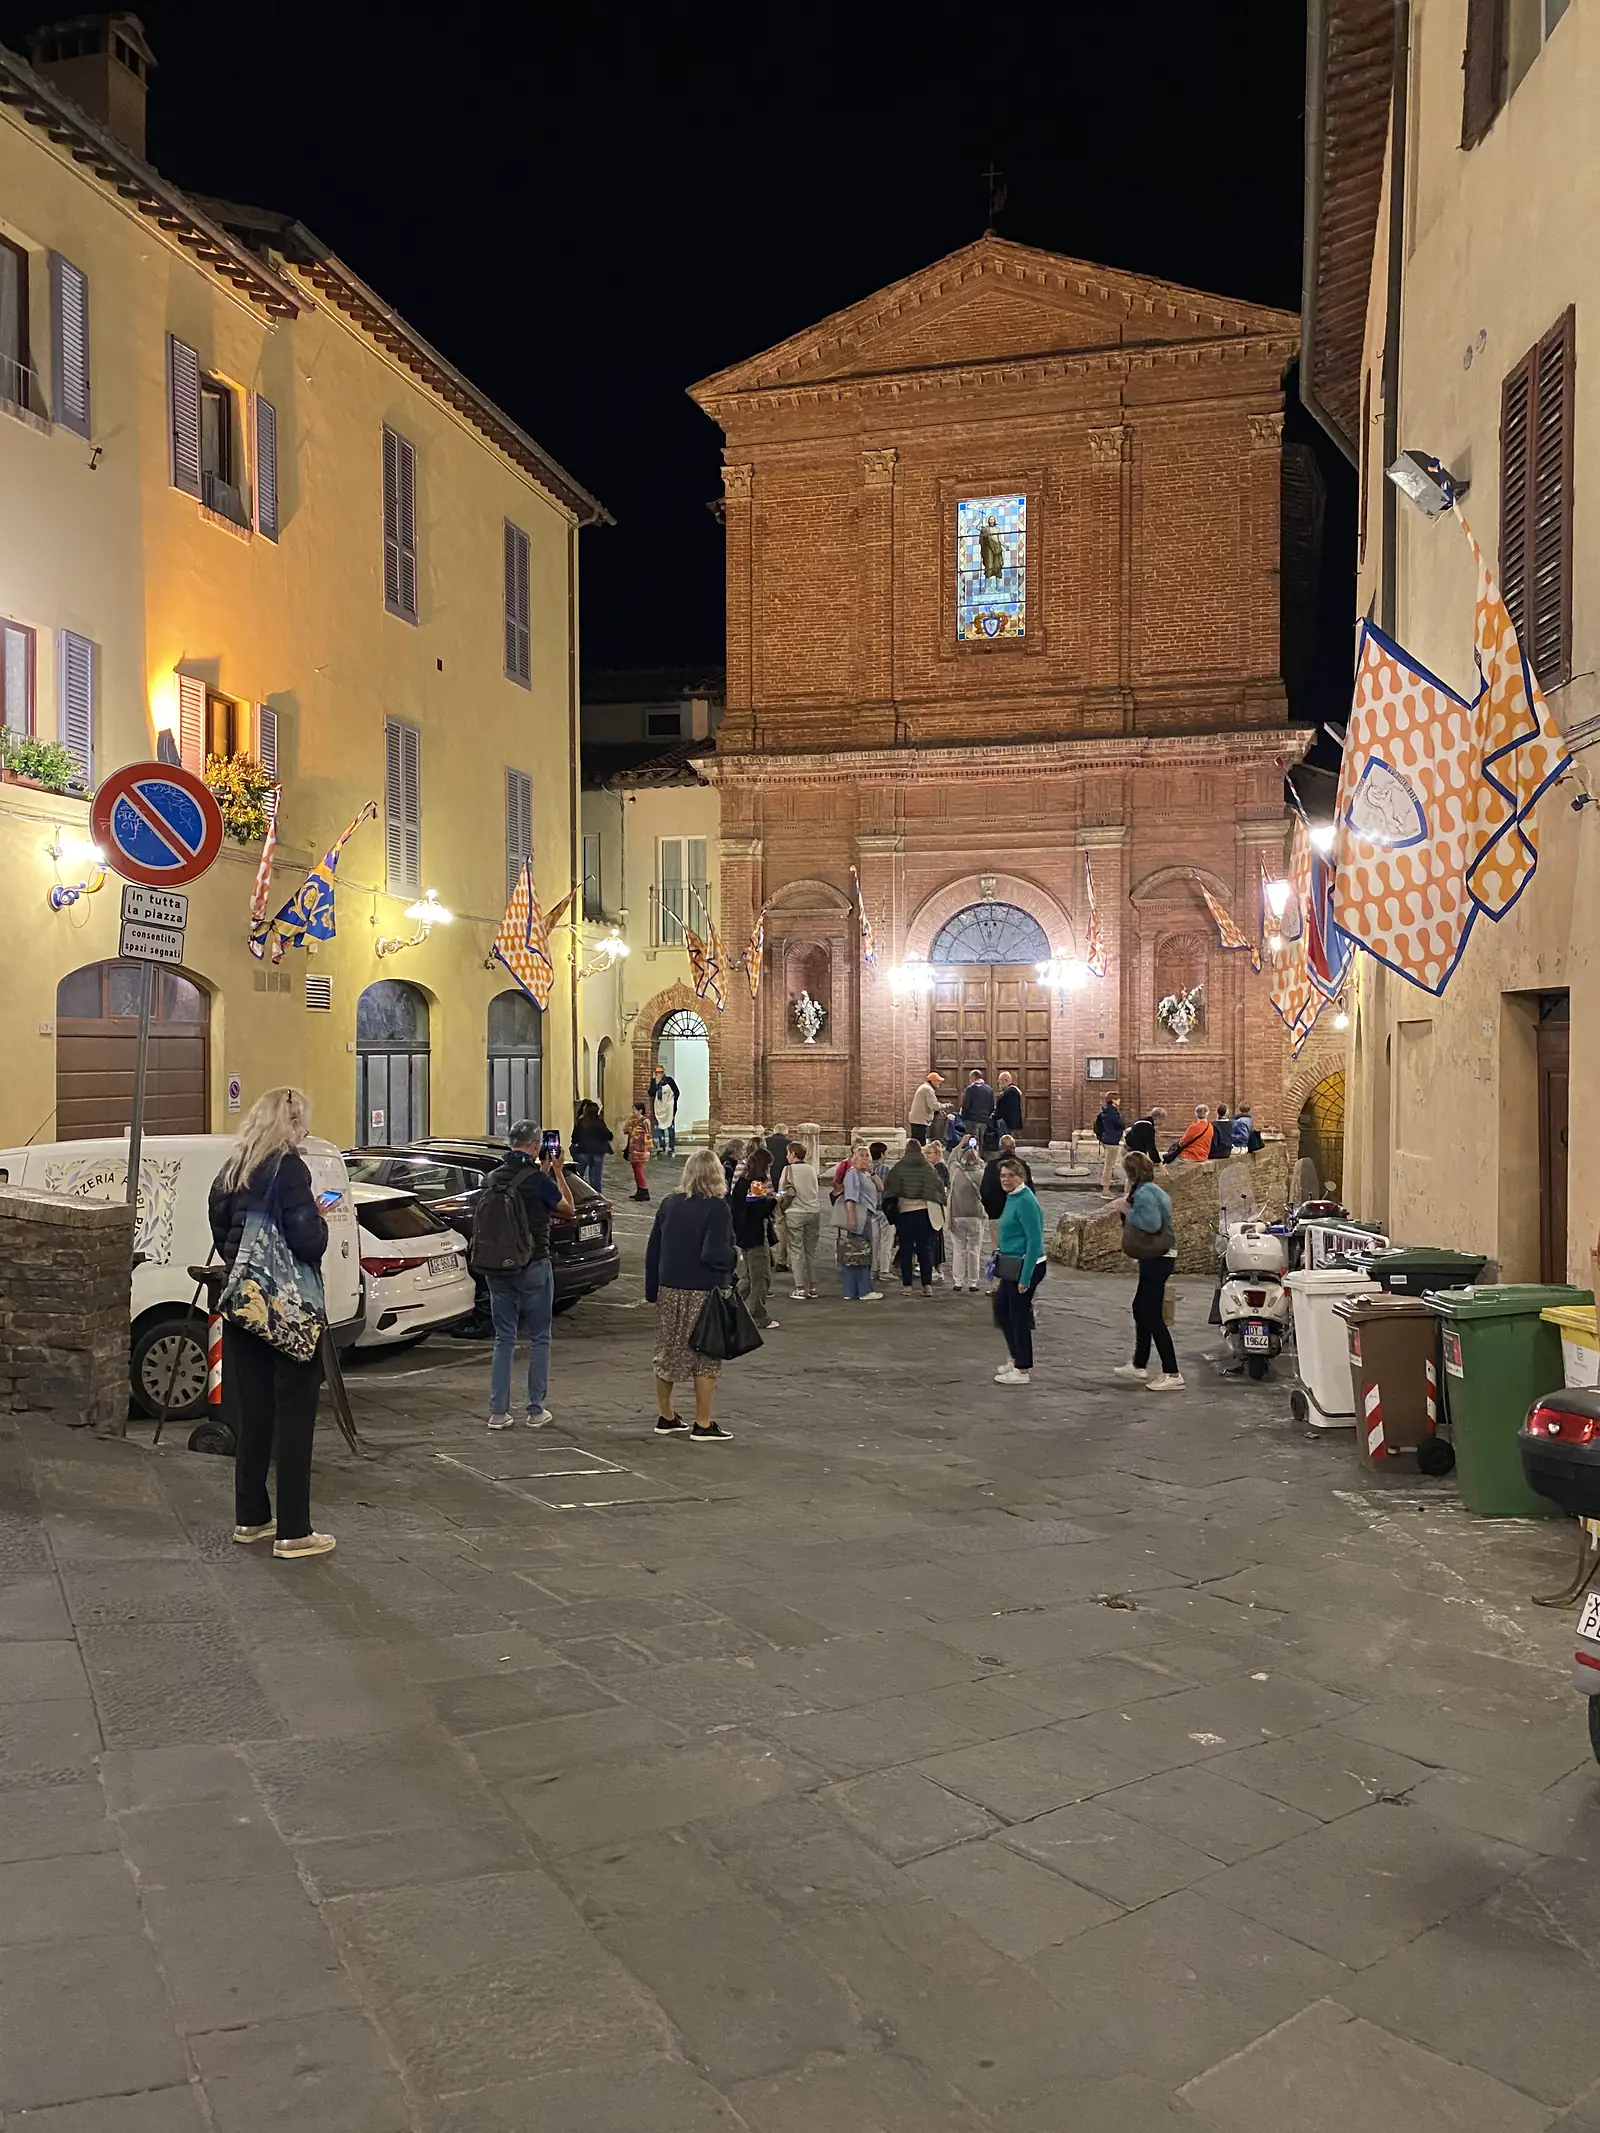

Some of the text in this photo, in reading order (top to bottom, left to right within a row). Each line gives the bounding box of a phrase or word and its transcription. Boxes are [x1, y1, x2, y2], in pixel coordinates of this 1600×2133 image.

[132, 890, 181, 909] in tutta
[127, 904, 183, 923] la piazza
[131, 930, 176, 944] consentito
[125, 942, 181, 959] spazi segnati
